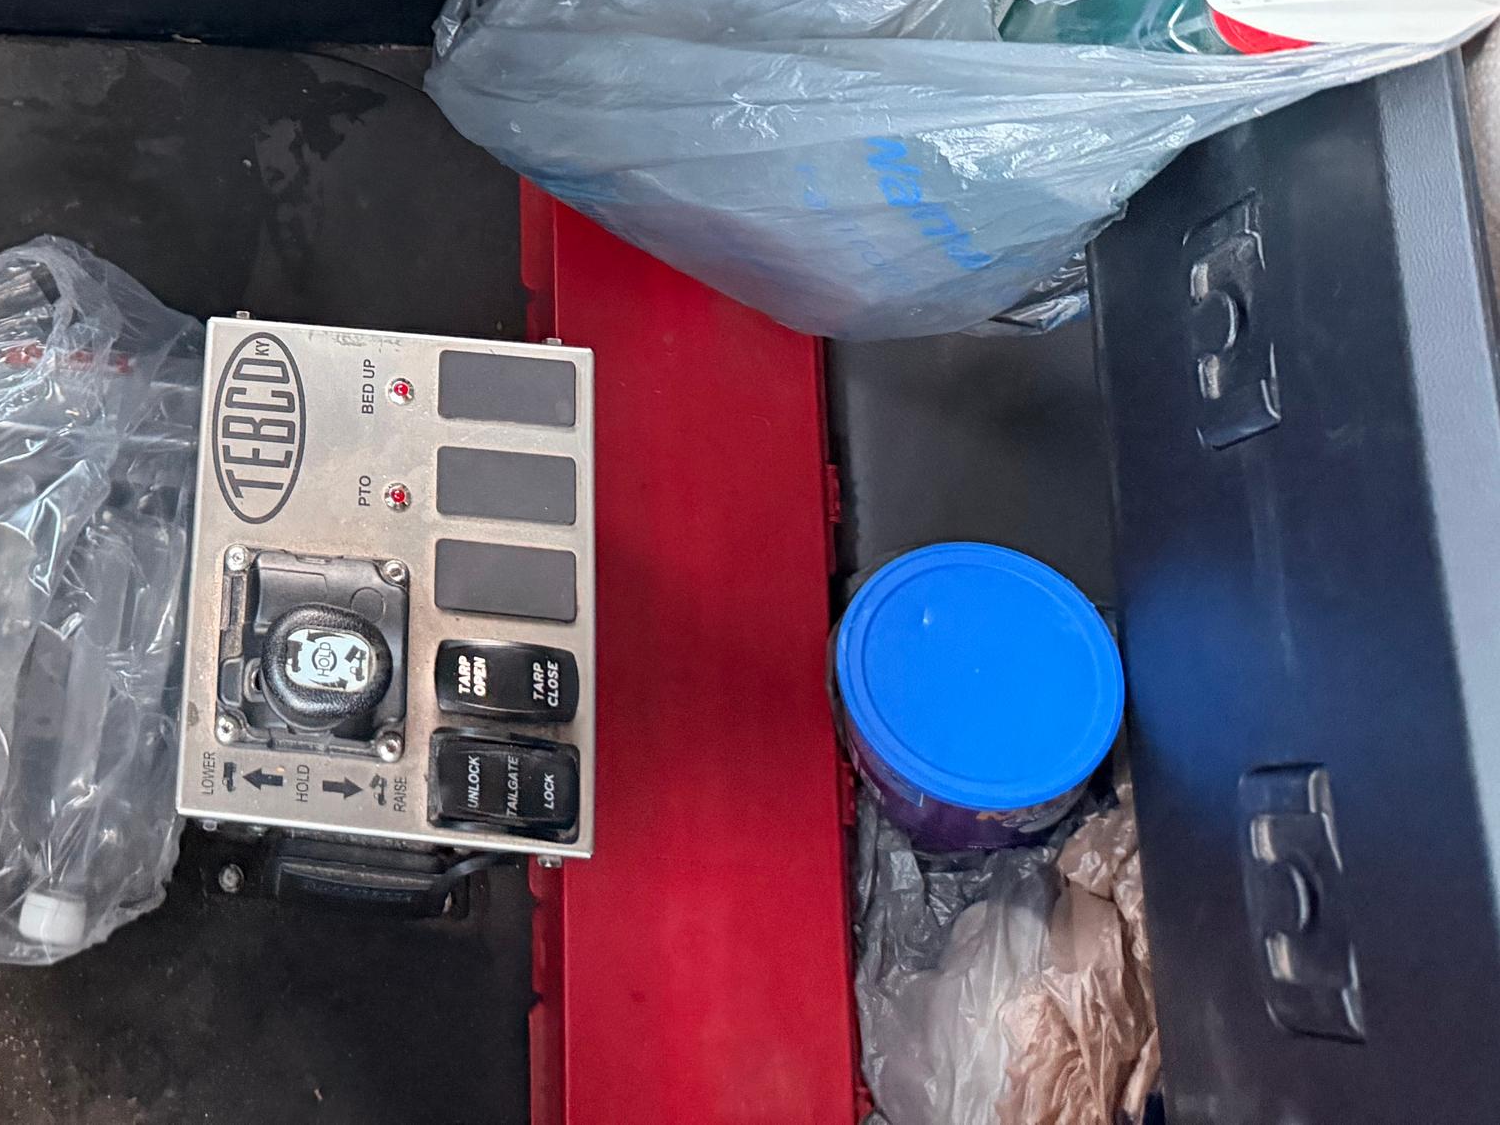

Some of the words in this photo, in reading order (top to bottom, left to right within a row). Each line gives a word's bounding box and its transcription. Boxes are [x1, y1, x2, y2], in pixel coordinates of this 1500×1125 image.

[255, 340, 270, 356] KY
[363, 358, 376, 379] UP
[362, 383, 375, 414] BED
[222, 357, 296, 498] TEBCO
[358, 475, 371, 506] PTO
[317, 642, 331, 677] HOLD
[458, 655, 471, 694] TARP
[473, 657, 486, 697] OPEN
[533, 662, 546, 700] TARP
[547, 661, 559, 707] CLOSE
[201, 751, 216, 795] LOWER
[296, 764, 310, 802] HOLD
[468, 755, 481, 808] UNLOCK
[506, 755, 519, 817] TAILGATE
[544, 772, 555, 810] LOCK
[394, 776, 408, 813] RAISE
